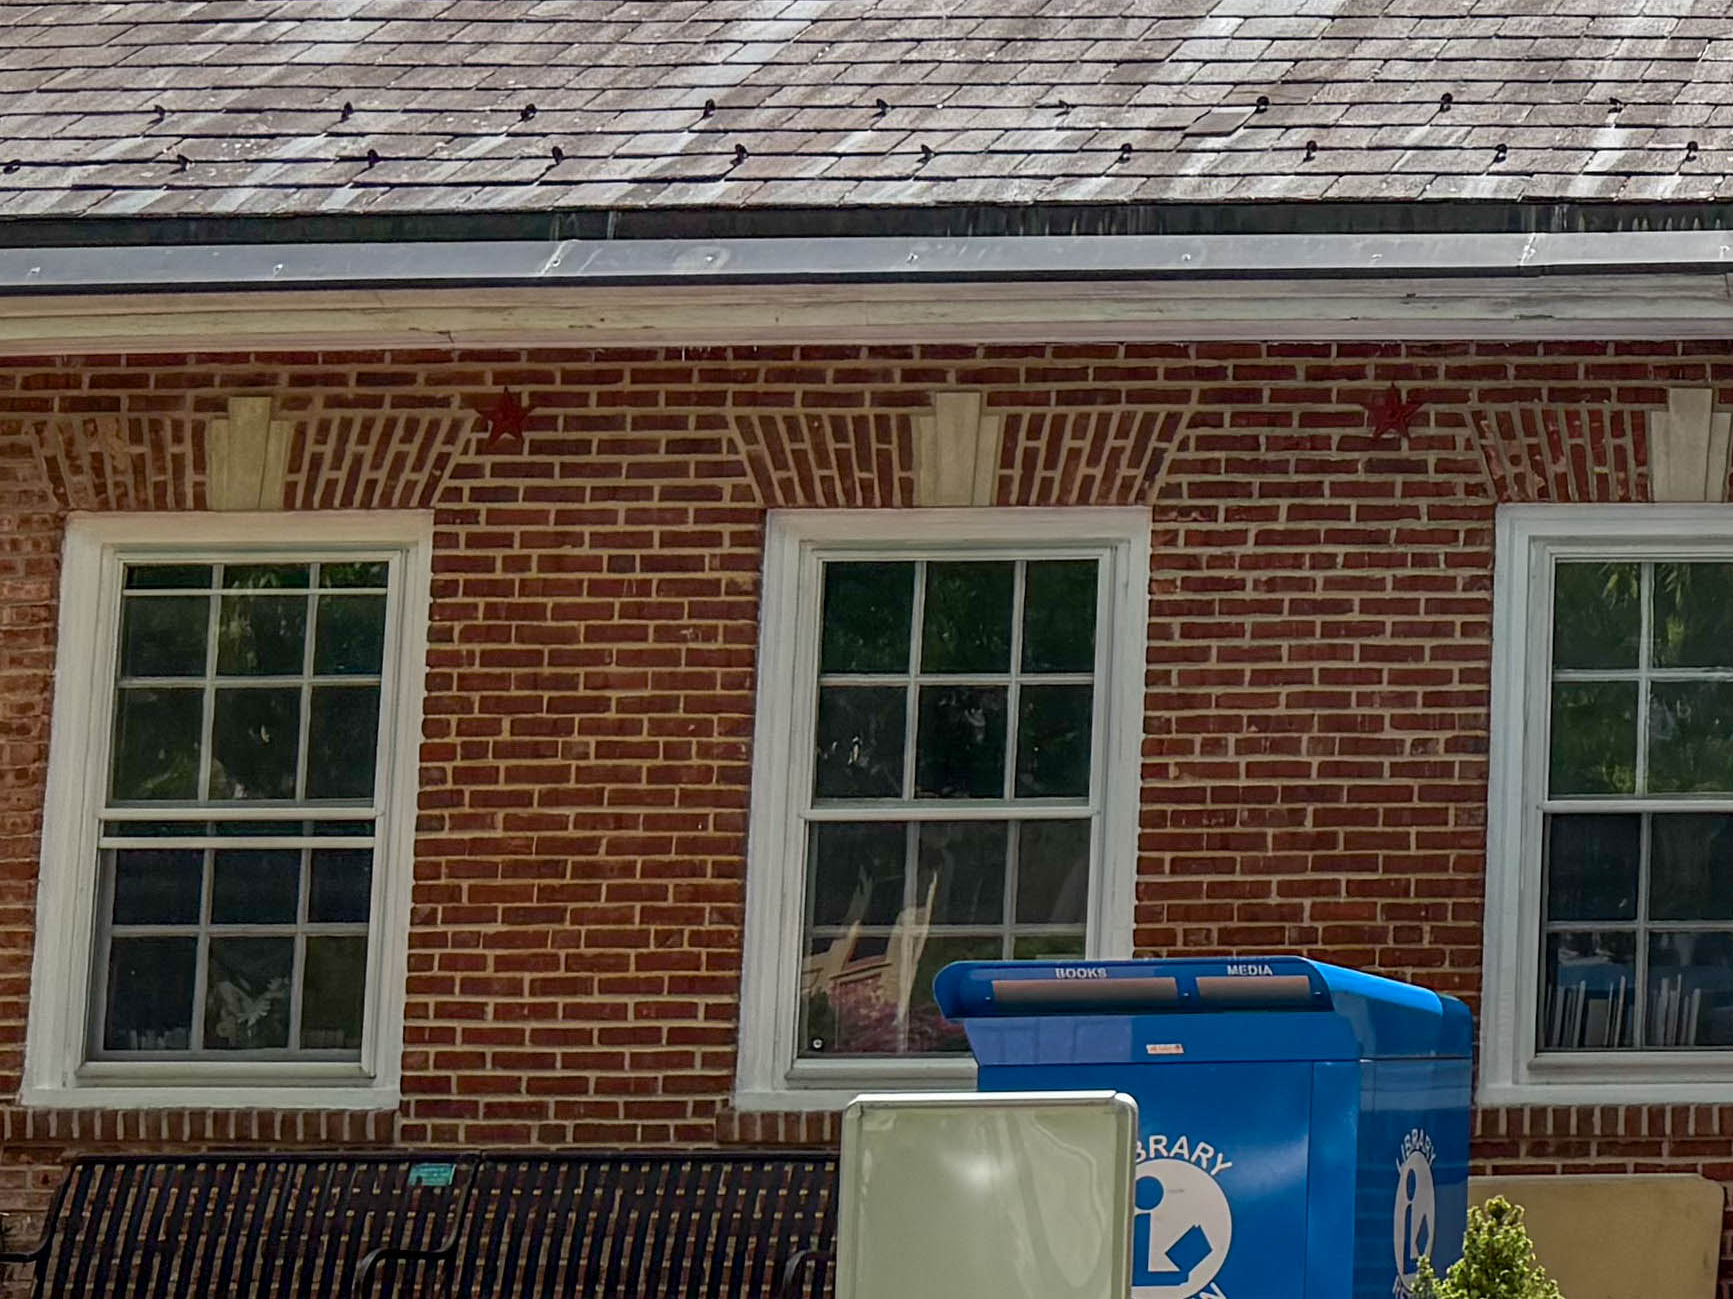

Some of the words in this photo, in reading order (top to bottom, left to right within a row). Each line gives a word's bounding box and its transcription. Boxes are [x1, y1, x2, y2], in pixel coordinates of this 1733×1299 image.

[1055, 967, 1108, 980] BOOKS
[1226, 963, 1274, 977] MEDIA
[1135, 1134, 1233, 1177] BRARY
[1396, 1127, 1436, 1174] LIBRARY
